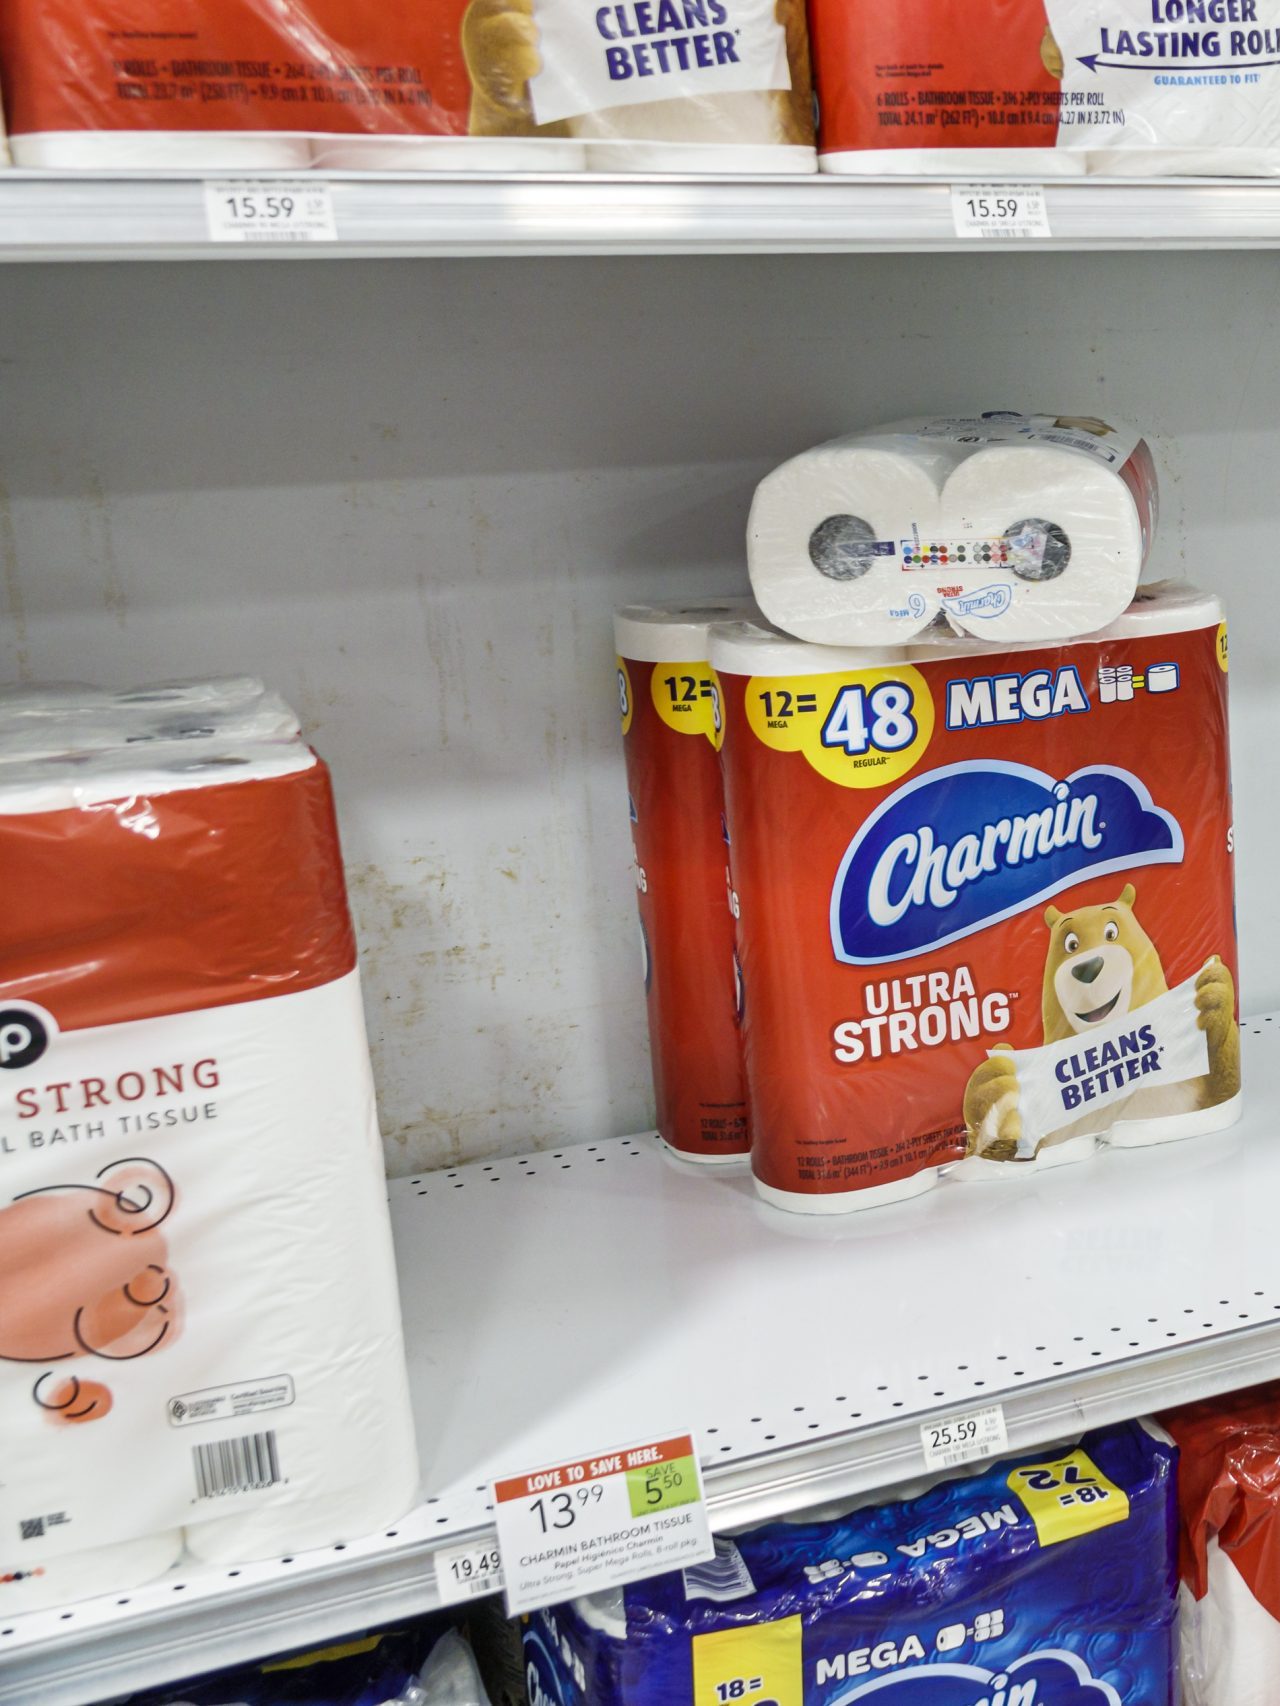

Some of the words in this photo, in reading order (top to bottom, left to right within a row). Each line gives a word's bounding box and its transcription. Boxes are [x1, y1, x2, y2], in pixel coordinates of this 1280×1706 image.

[596, 0, 728, 41] CLEANS
[1152, 0, 1258, 24] LONGER
[1100, 27, 1221, 58] LASTING
[1153, 75, 1227, 87] GUARANTEED
[1230, 75, 1242, 85] TO
[1070, 92, 1086, 106] PER
[1086, 92, 1105, 106] ROLL
[226, 197, 294, 218] 15.59
[967, 199, 1018, 218] 15.59
[889, 608, 910, 618] MEGA
[958, 590, 1006, 612] Charmin
[672, 703, 693, 713] MEGA
[946, 665, 1090, 731] MEGA
[767, 719, 789, 729] MEGA
[821, 682, 918, 756] 48
[868, 781, 1103, 926] Charmin
[865, 966, 976, 1016] ULTRA
[1054, 1024, 1157, 1084] CLEANS
[15, 1058, 221, 1119] STRONG
[30, 1121, 106, 1149] BATH
[118, 1102, 219, 1135] TISSUE
[930, 1420, 977, 1448] 25.59
[526, 1469, 562, 1492] LOVE
[566, 1466, 584, 1484] TO
[589, 1456, 622, 1479] SAVE
[627, 1446, 664, 1469] HERE.
[645, 1461, 677, 1479] SAVE
[1018, 1466, 1098, 1491] 72
[519, 1543, 578, 1568] CHARMIN
[581, 1524, 651, 1552] BATHROOM
[653, 1513, 693, 1532] TISSUE
[896, 1504, 1020, 1559] MEGA
[450, 1551, 501, 1580] 19.49
[554, 1557, 580, 1570] Papel
[626, 1535, 664, 1551] Charmin
[519, 1579, 541, 1591] Ultra
[576, 1563, 603, 1577] Super
[604, 1556, 631, 1569] Mega
[815, 1633, 926, 1685] MEGA
